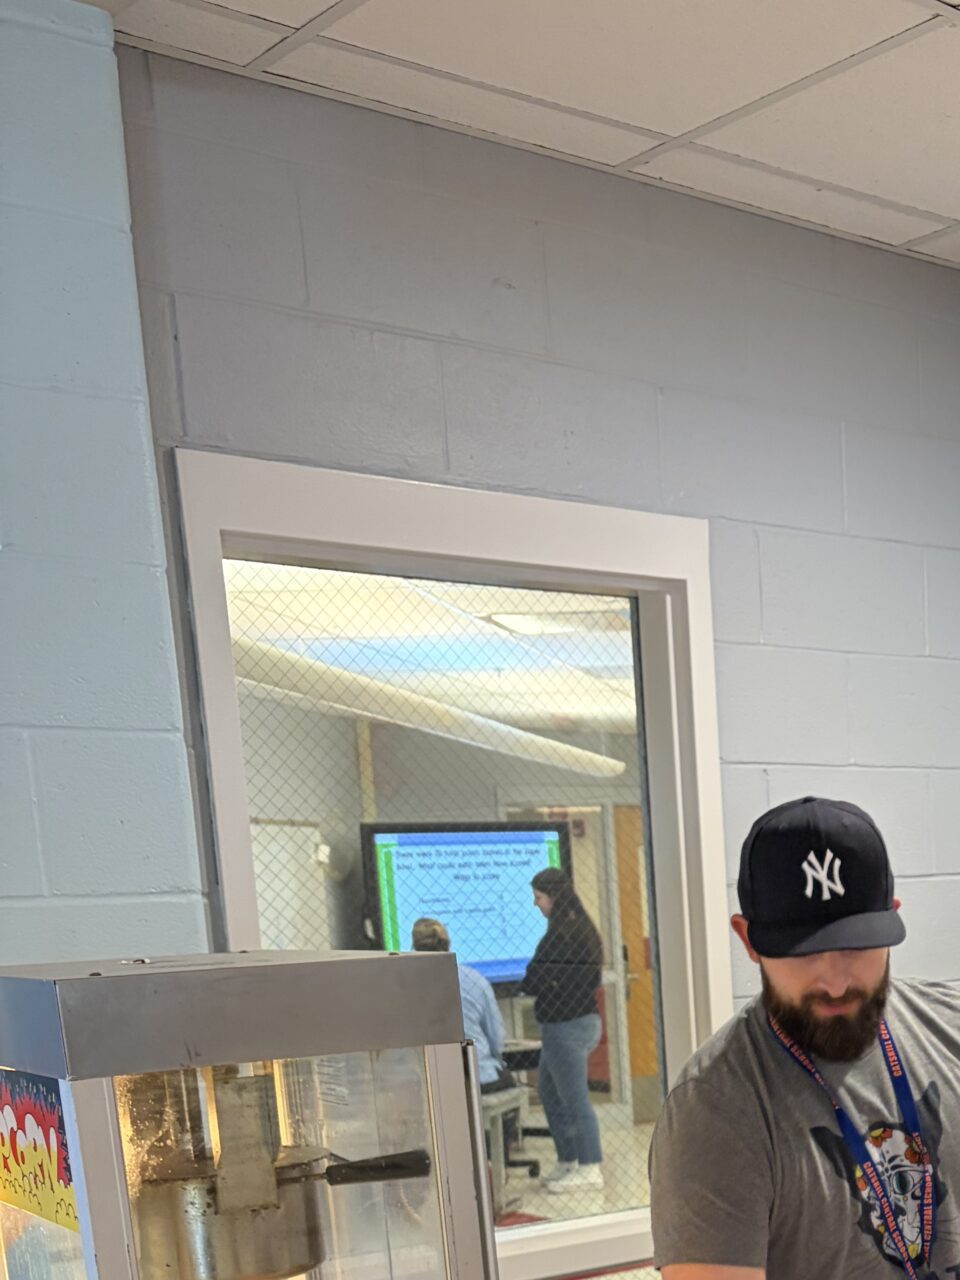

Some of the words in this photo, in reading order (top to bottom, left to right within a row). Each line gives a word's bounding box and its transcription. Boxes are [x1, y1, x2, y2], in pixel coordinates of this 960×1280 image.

[801, 848, 845, 901] NY
[863, 1160, 885, 1199] CATSKILL
[881, 1195, 897, 1233] CENTRAL
[923, 1204, 933, 1241] CENTRAL
